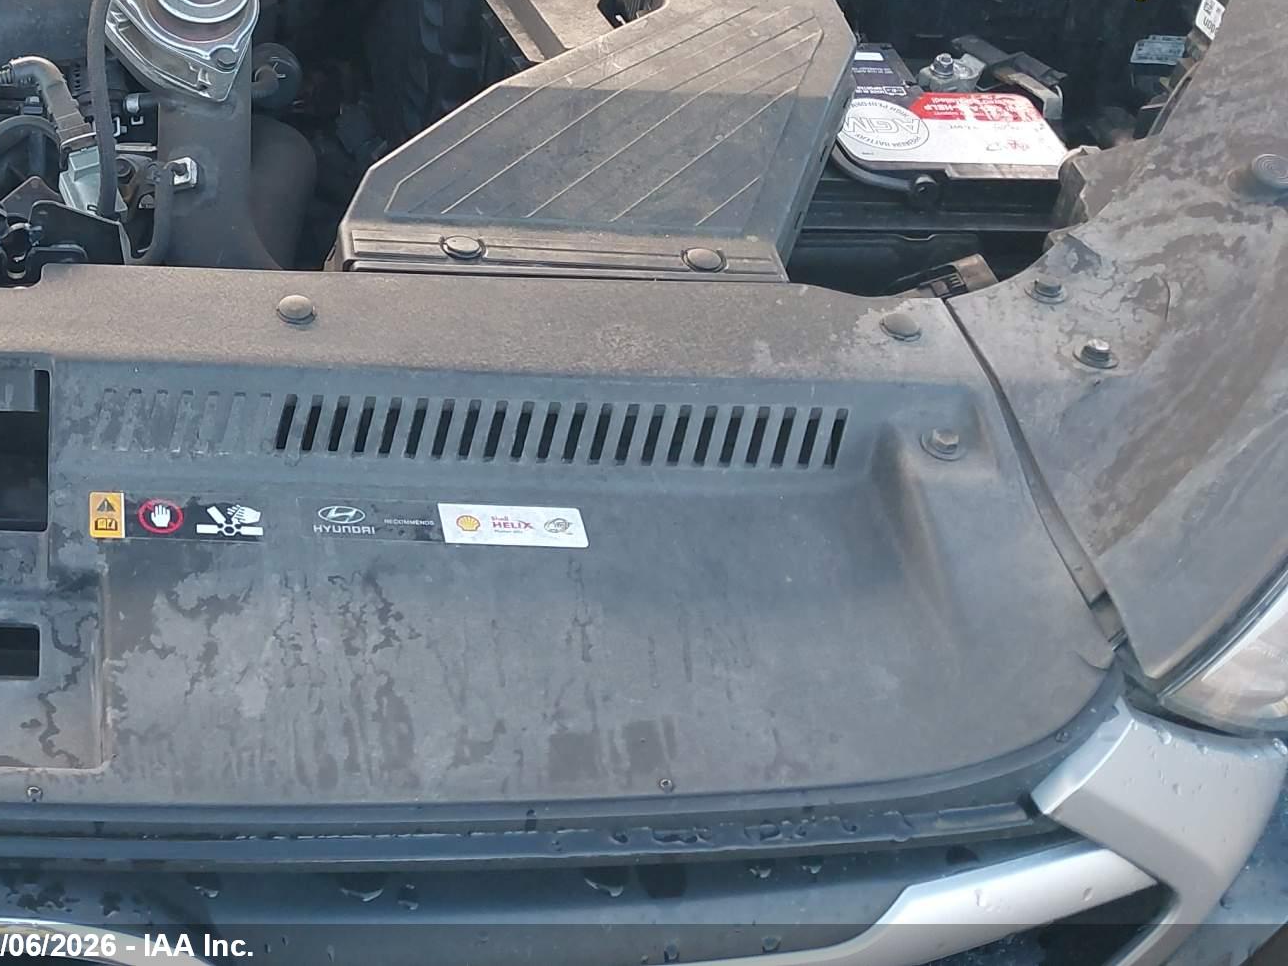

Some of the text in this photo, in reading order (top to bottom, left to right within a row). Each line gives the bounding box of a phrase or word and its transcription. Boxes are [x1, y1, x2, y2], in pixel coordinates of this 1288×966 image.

[843, 117, 921, 135] AGM
[312, 518, 435, 535] HYUNDAI RECOMMENDS
[492, 520, 534, 530] HELIX
